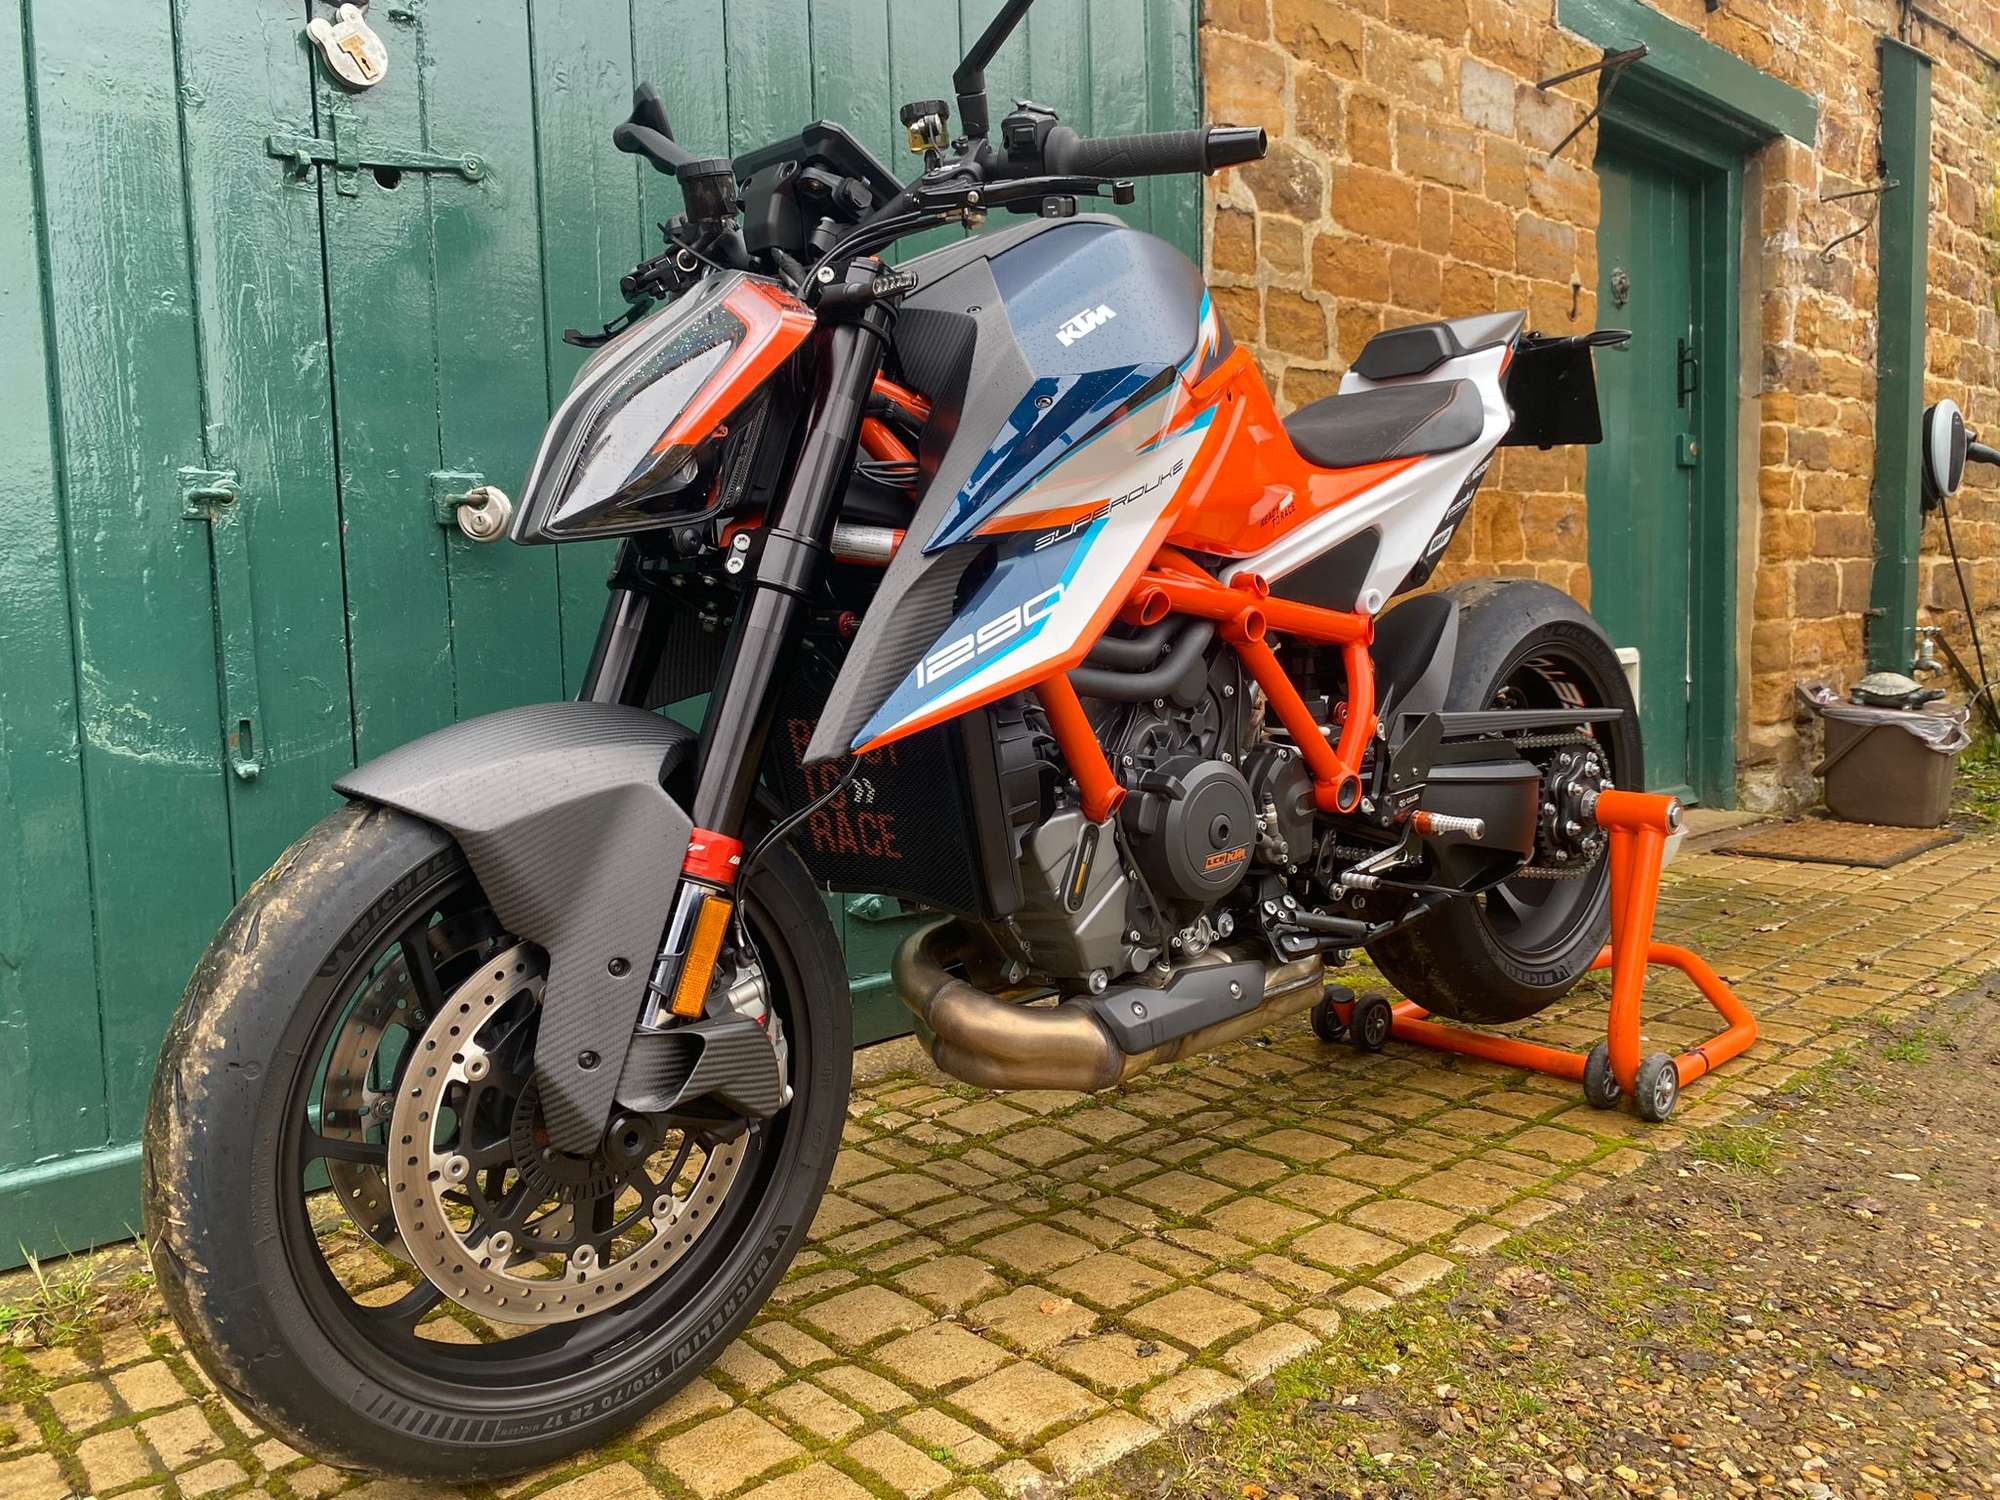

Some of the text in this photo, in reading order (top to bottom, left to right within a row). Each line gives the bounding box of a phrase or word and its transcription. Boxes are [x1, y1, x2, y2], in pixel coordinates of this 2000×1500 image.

[1055, 304, 1117, 347] KTM
[1033, 458, 1184, 551] SUPERDUKE
[912, 583, 1065, 688] 1290
[810, 810, 903, 859] RACE
[676, 1254, 769, 1364] MICHELIN
[601, 1367, 662, 1409] 120/70
[542, 1414, 563, 1431] 17
[569, 1402, 594, 1422] ZR
